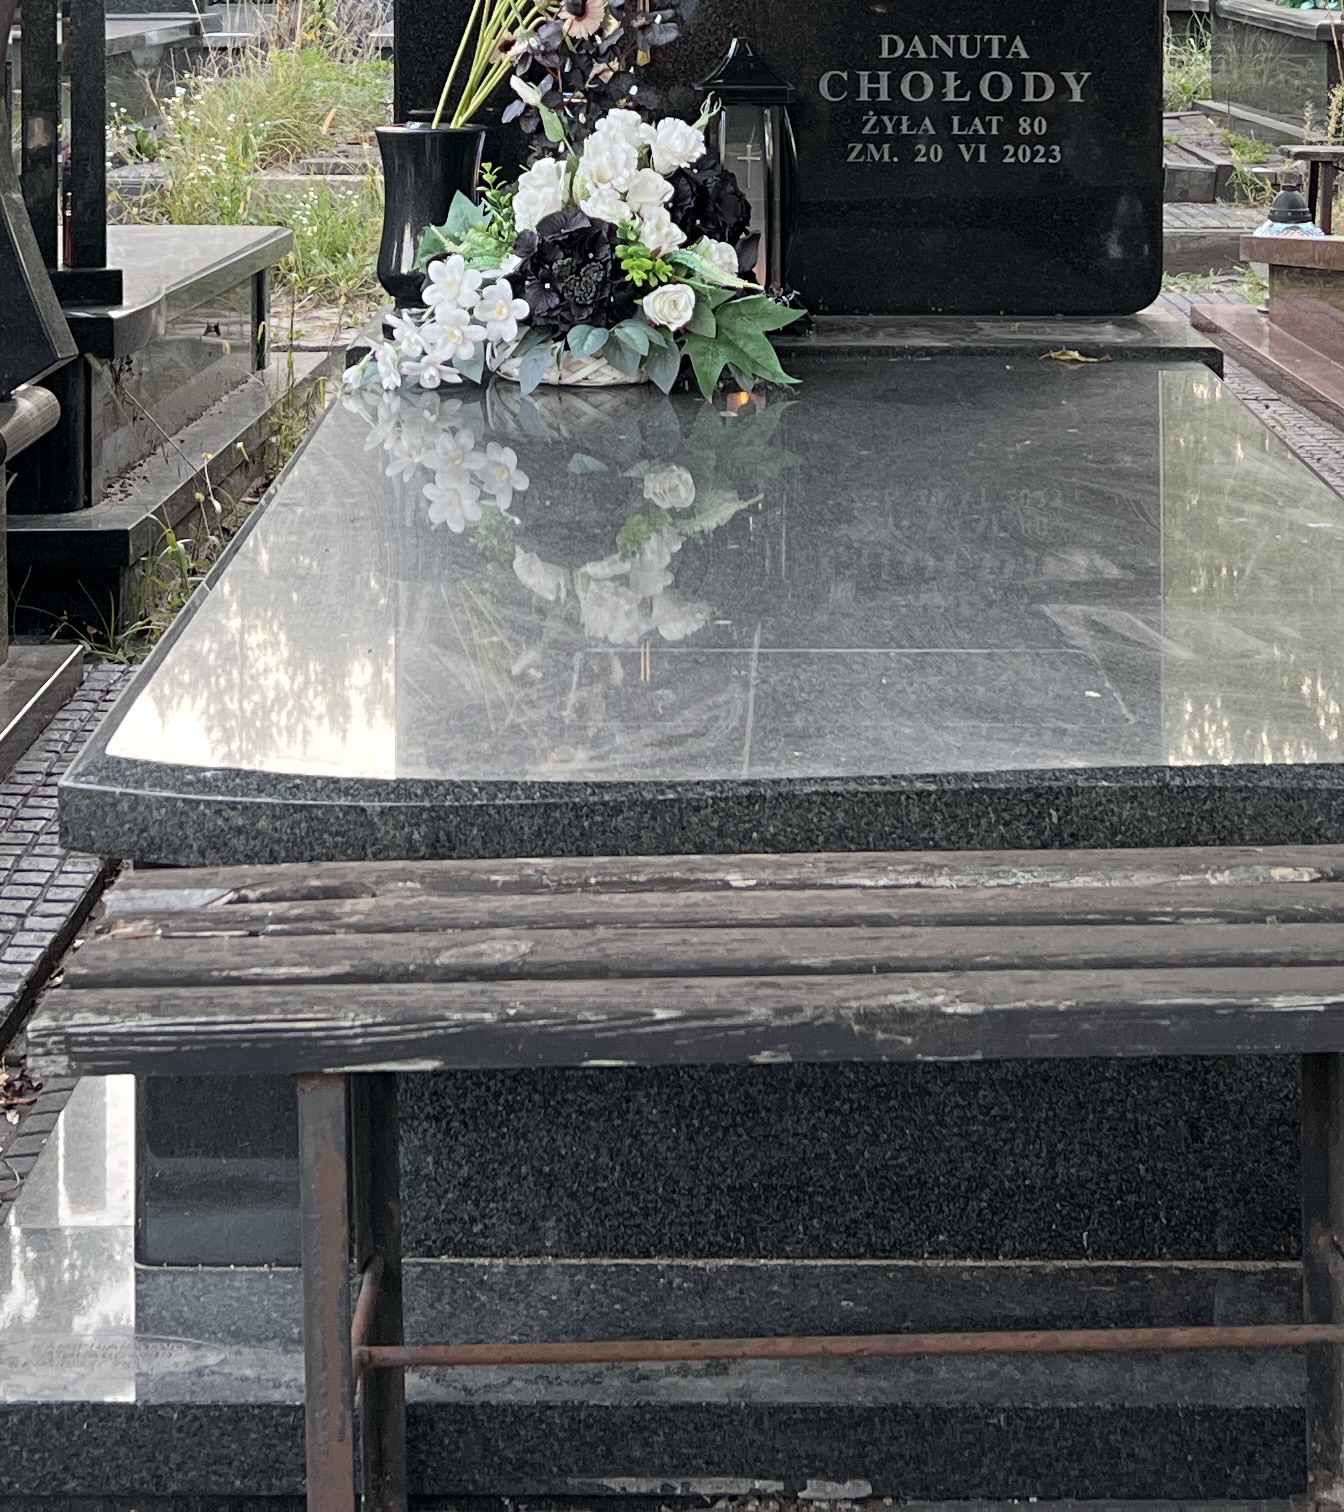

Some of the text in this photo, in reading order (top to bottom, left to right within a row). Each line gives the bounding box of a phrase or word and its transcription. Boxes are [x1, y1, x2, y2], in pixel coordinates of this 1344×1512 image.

[878, 34, 1030, 59] DANUTA
[818, 70, 1093, 103] CHOŁODY
[861, 110, 1047, 136] ŻYŁA LAT 80
[846, 143, 1062, 164] ZM. 20 VI 2023
